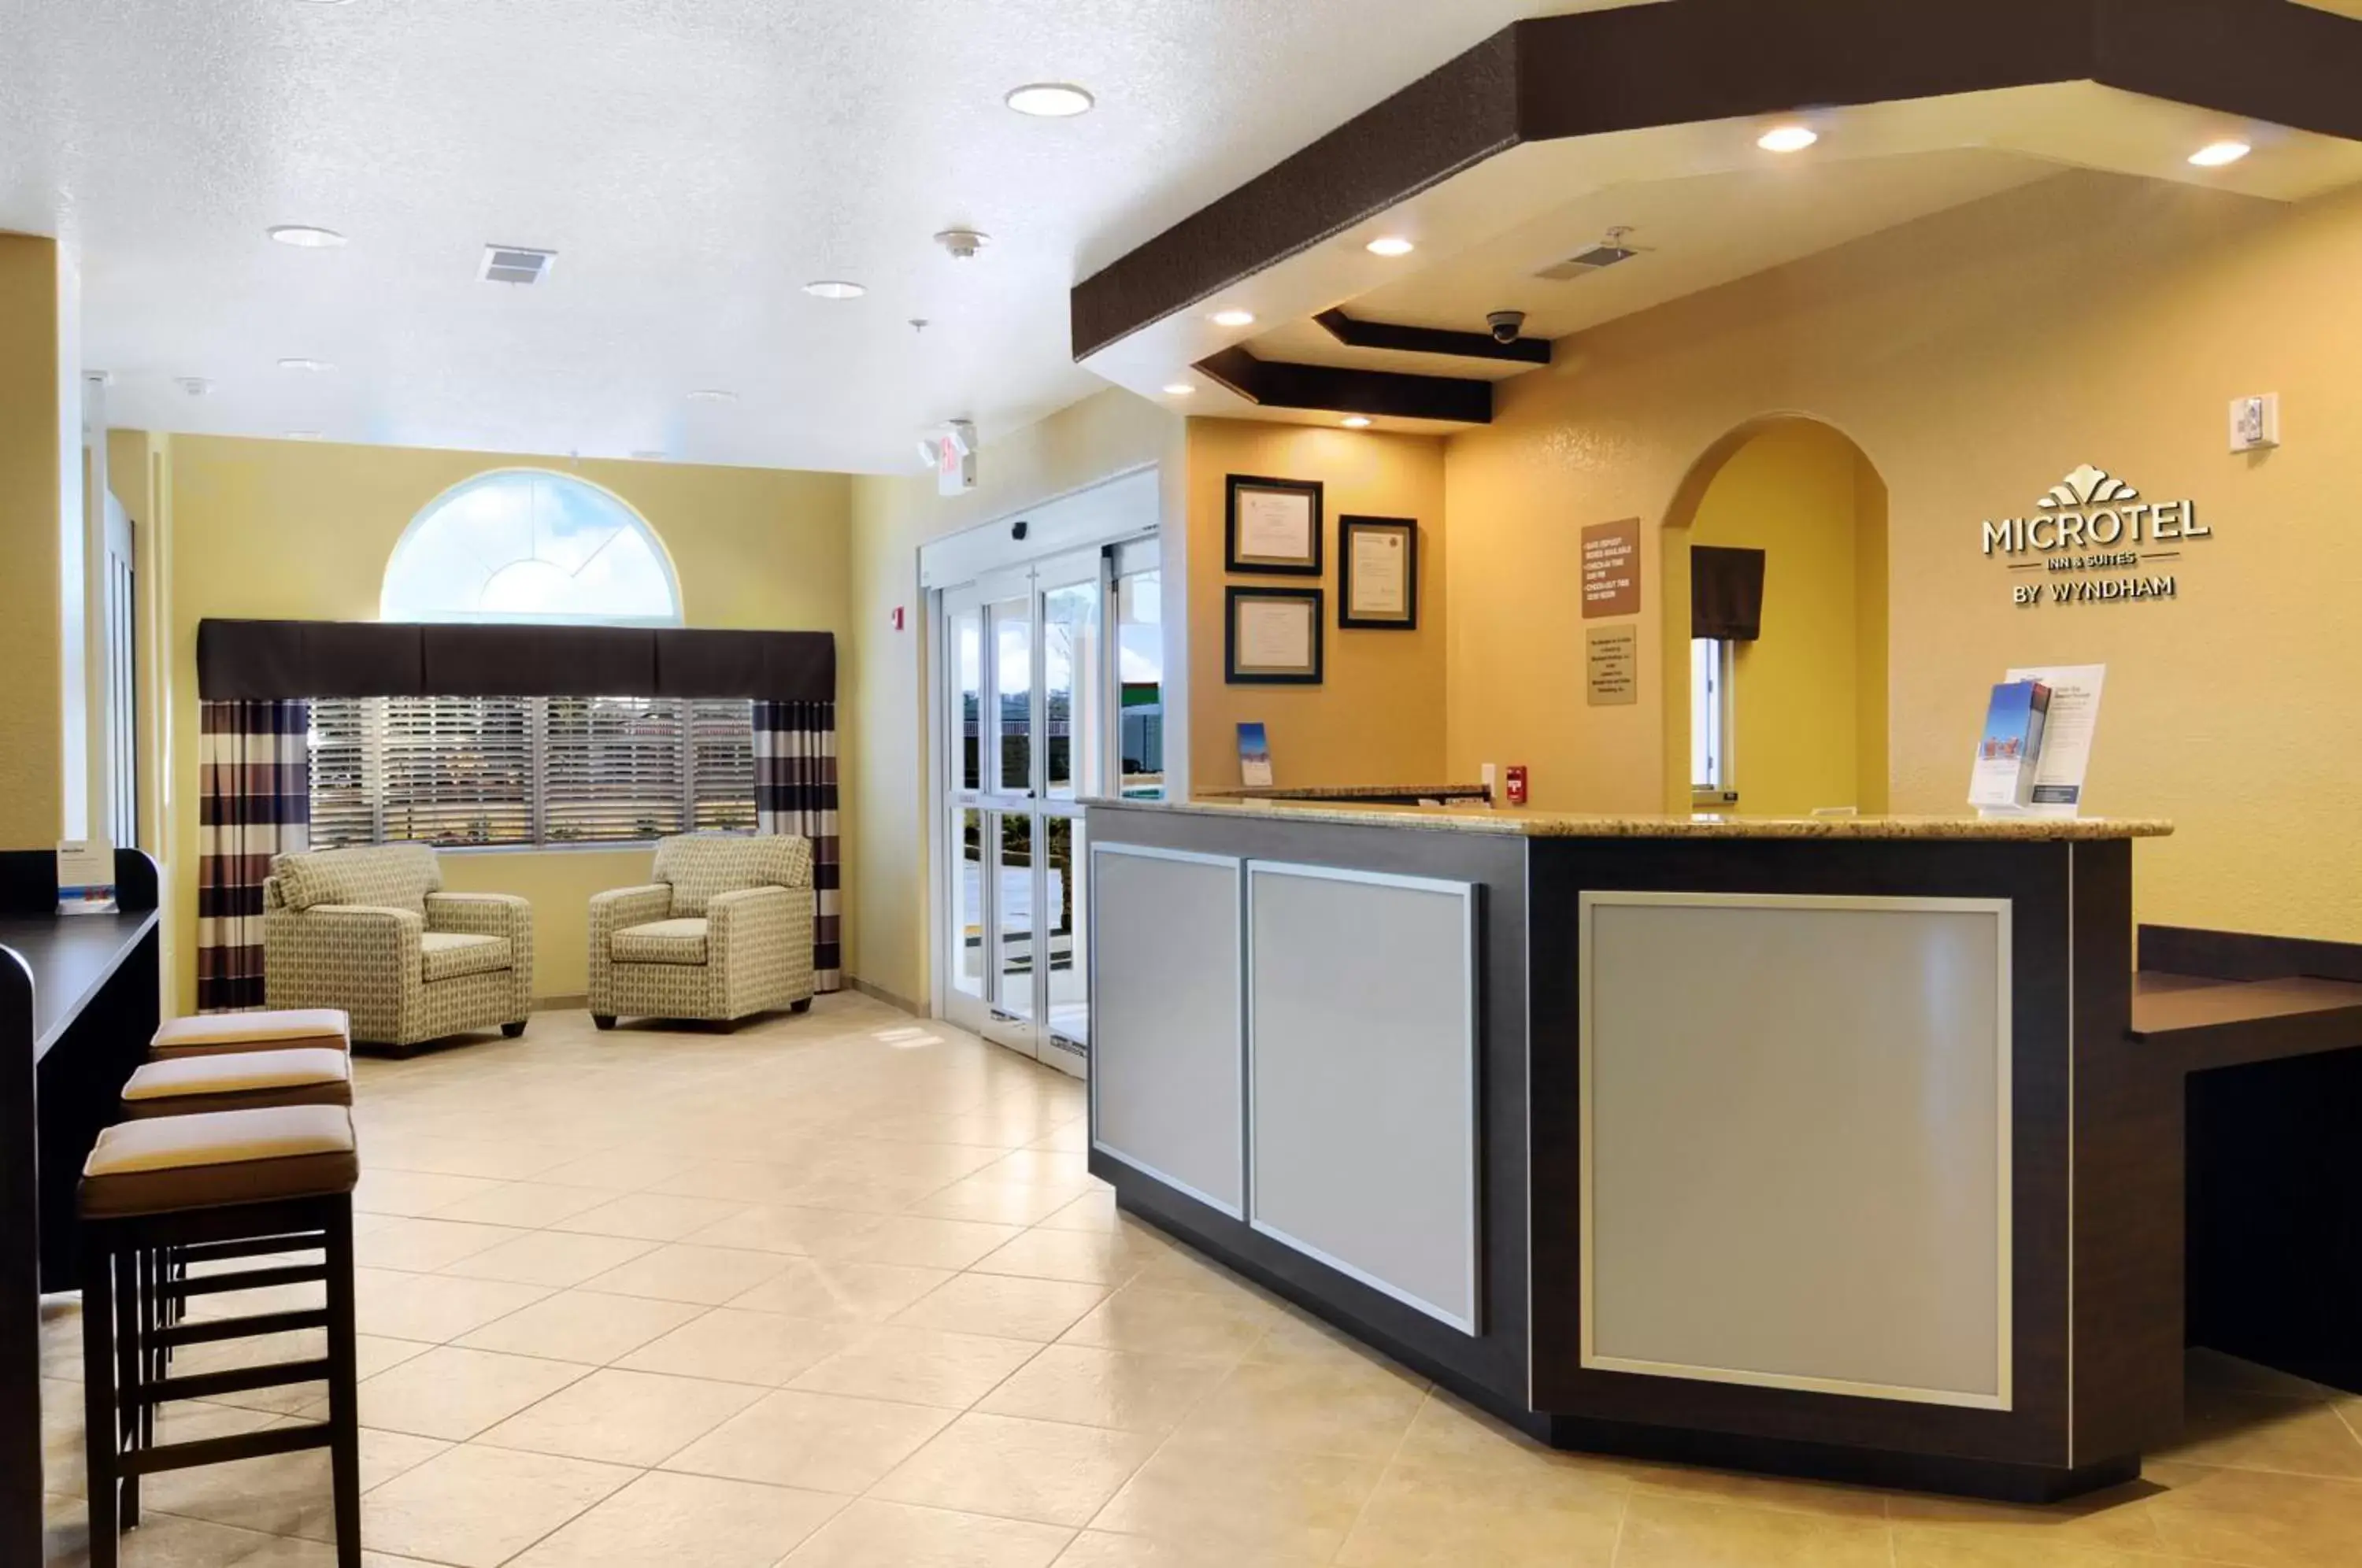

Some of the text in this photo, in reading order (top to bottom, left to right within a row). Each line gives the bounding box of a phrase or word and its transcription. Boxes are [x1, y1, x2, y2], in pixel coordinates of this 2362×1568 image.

[1982, 500, 2211, 554] MICROTEL
[2048, 552, 2138, 570] INN & SUITES
[2013, 575, 2175, 604] BY WYNDHAM
